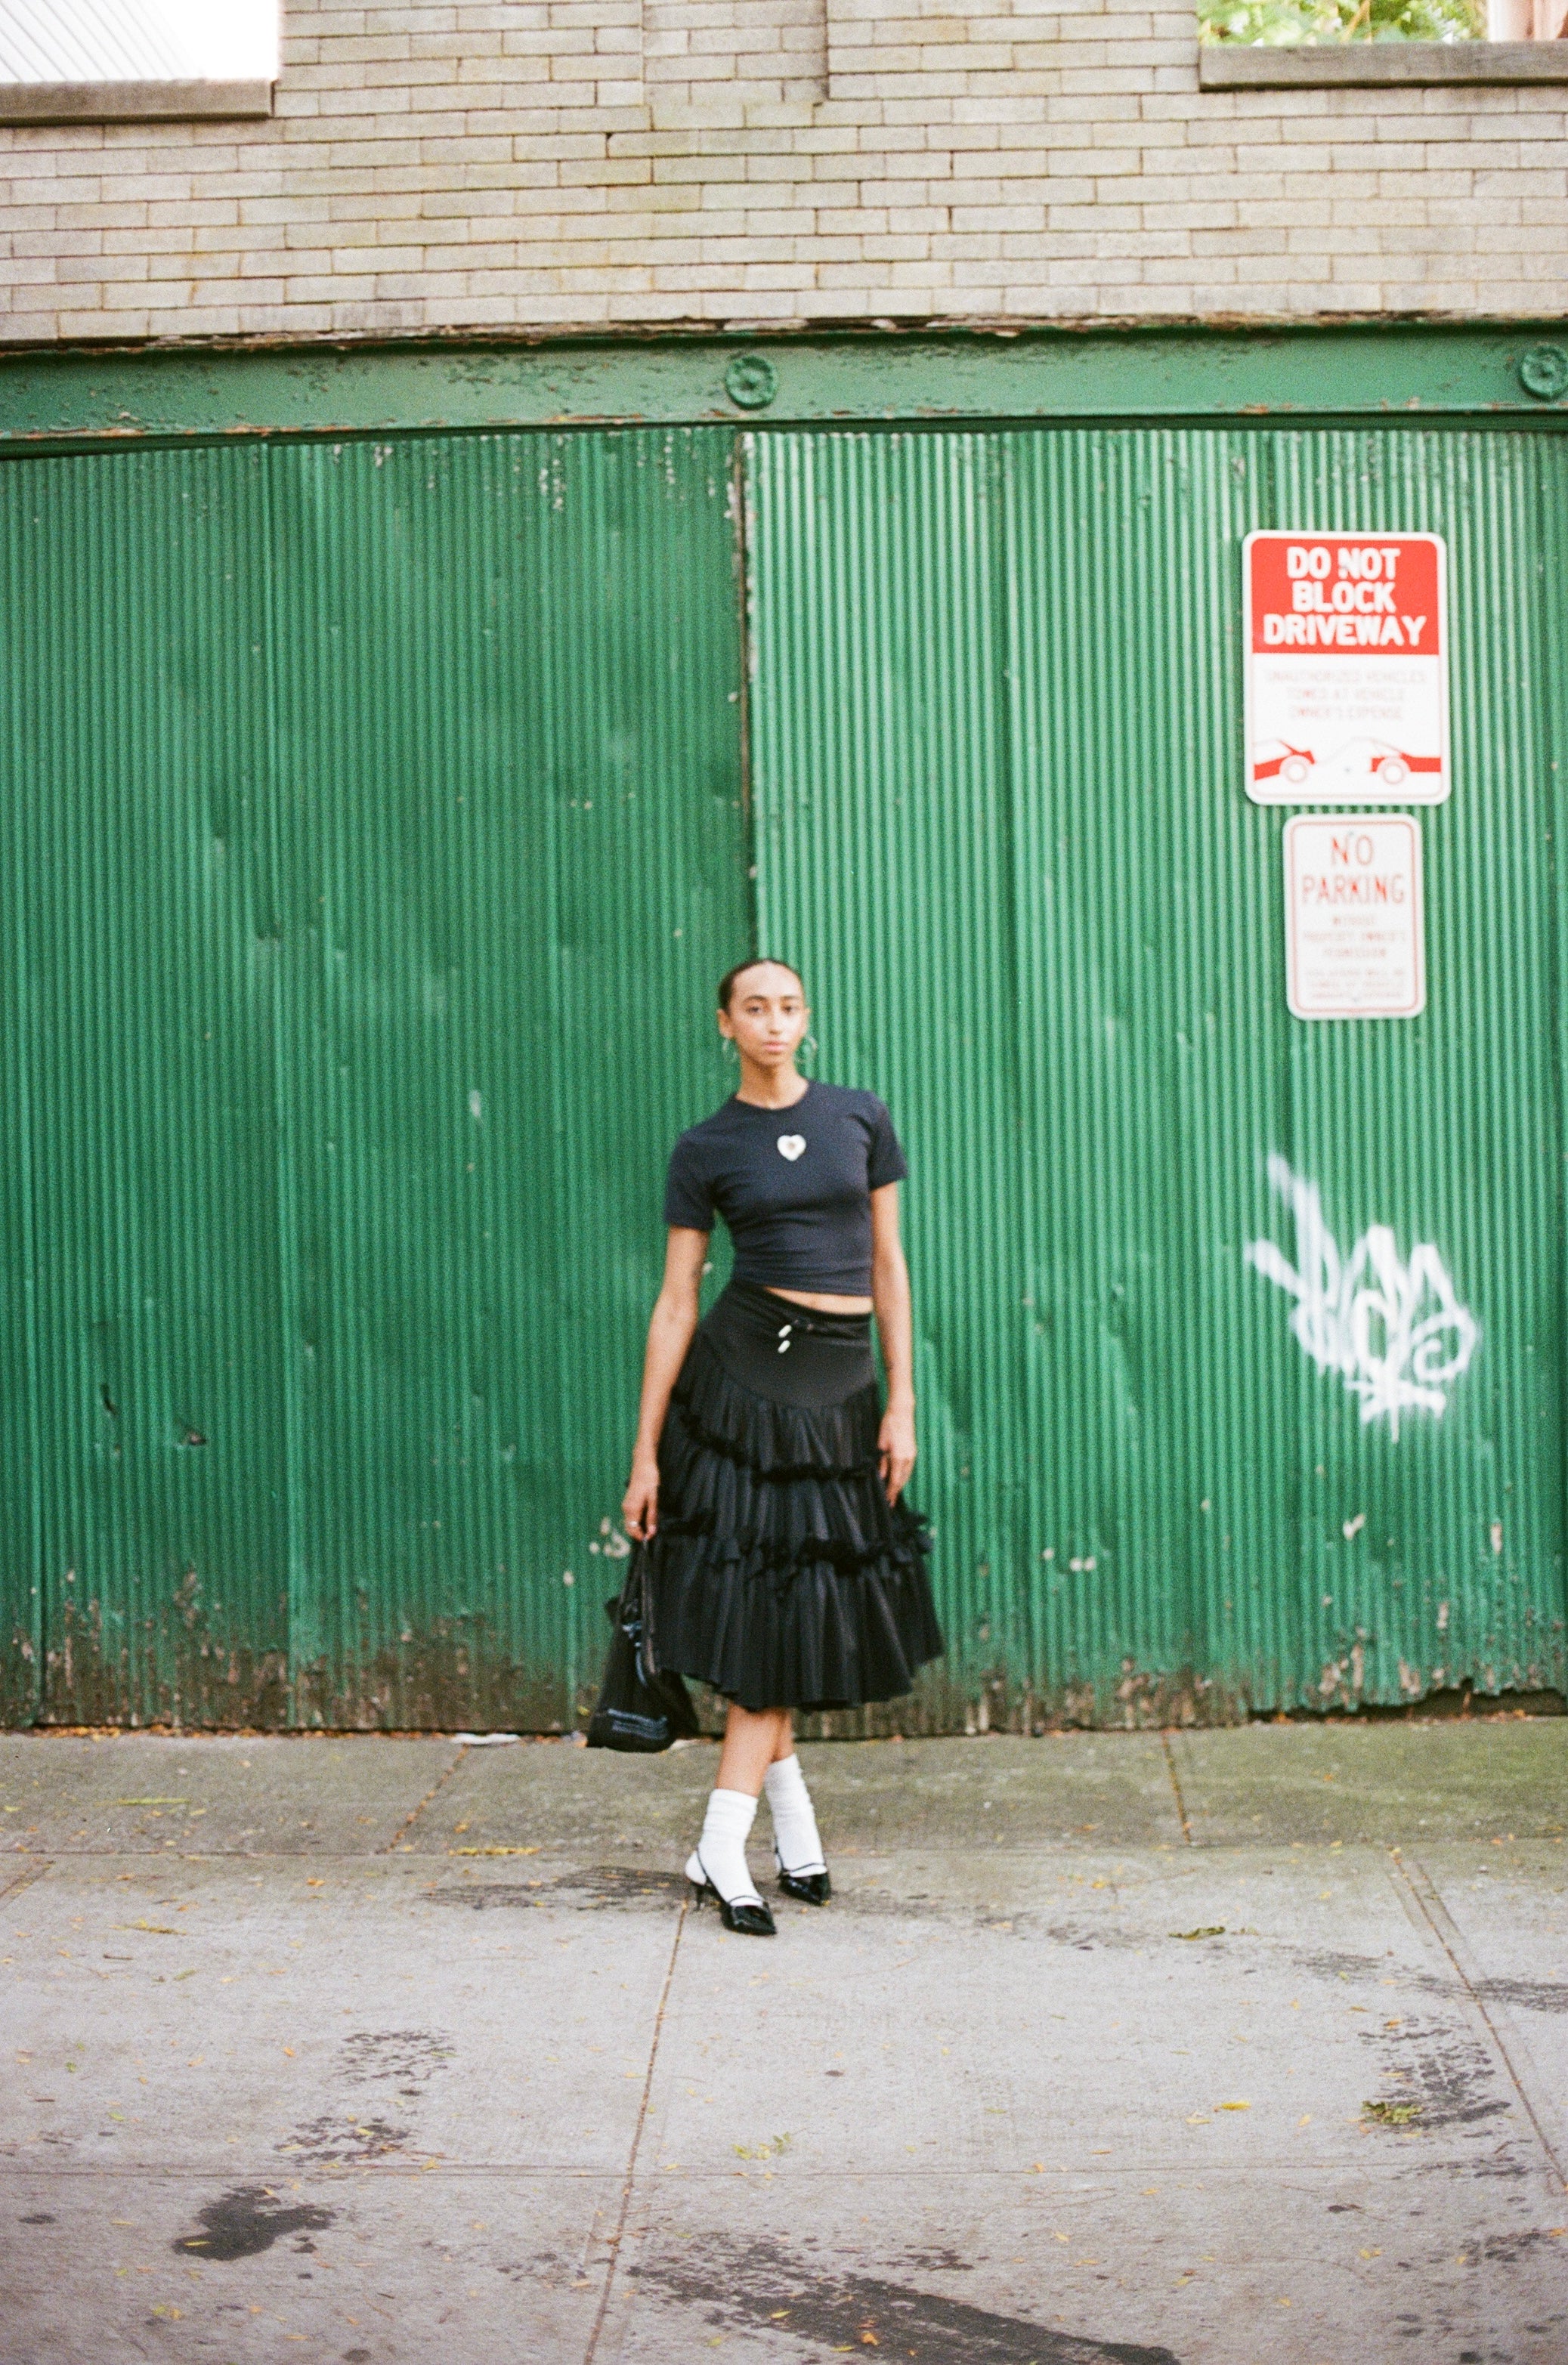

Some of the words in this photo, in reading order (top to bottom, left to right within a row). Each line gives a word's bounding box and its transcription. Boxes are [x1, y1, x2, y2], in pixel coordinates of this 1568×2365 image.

[1286, 546, 1331, 580] DO
[1338, 547, 1401, 580] NOT
[1291, 580, 1396, 613] BLOCK
[1263, 614, 1427, 646] DRIVEWAY
[1331, 833, 1374, 867] NO
[1300, 873, 1405, 904] PARKING
